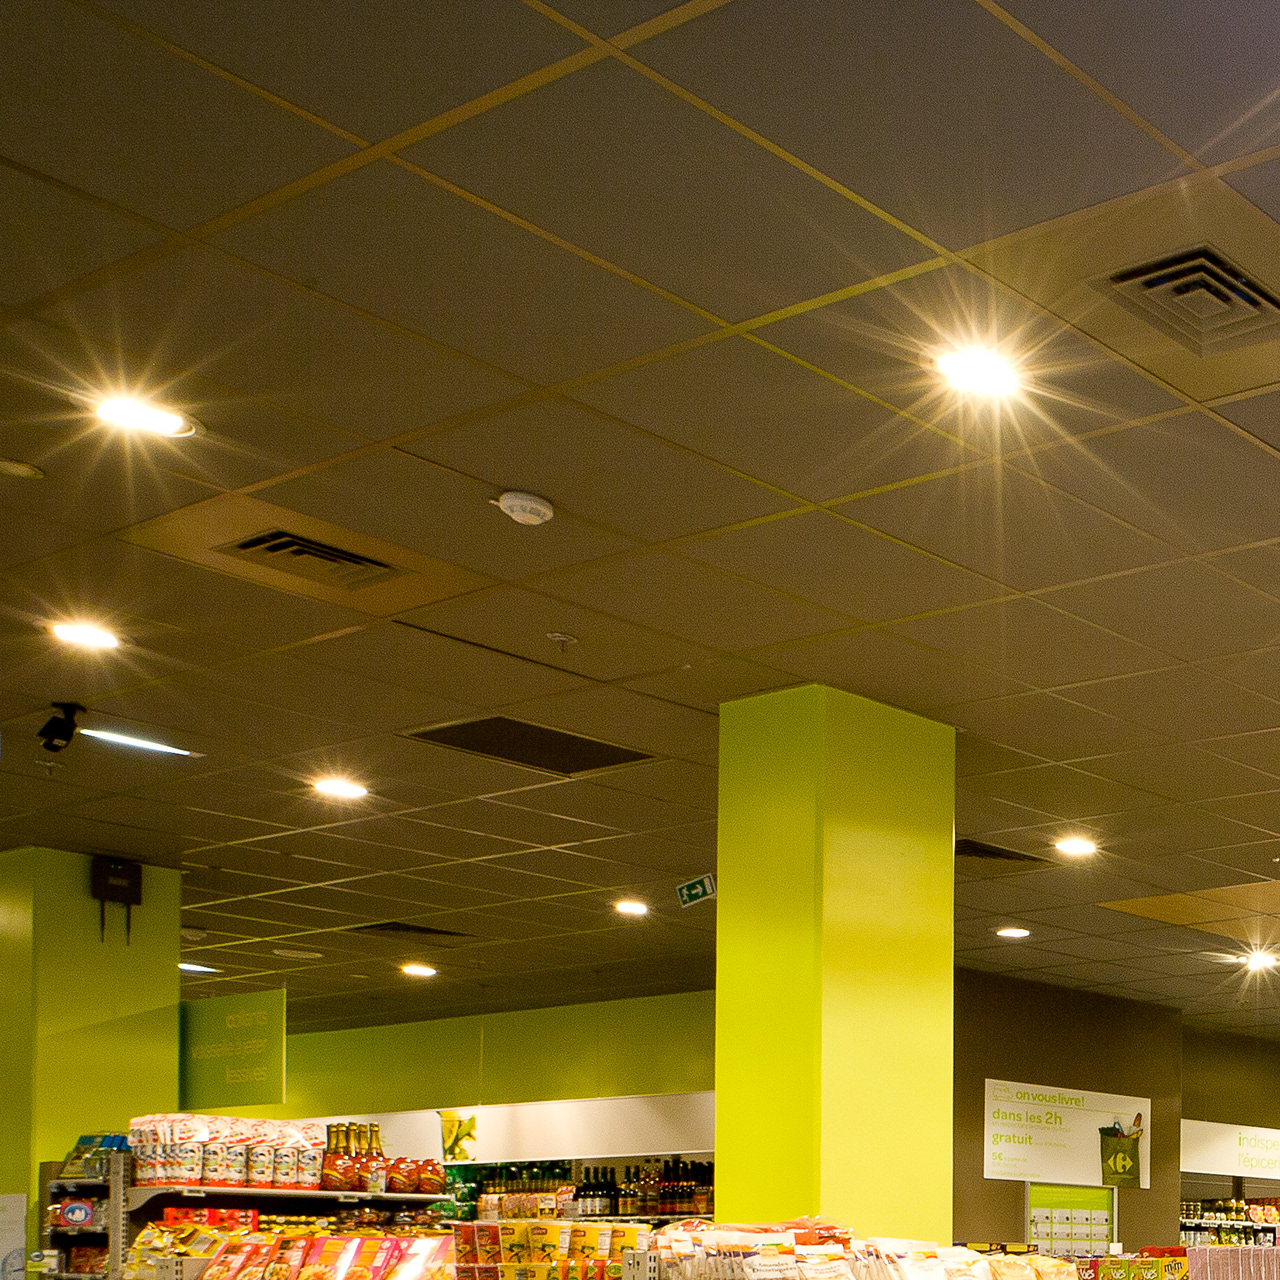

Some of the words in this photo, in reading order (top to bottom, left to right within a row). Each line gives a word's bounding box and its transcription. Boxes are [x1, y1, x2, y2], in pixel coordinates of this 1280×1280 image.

[1016, 1090, 1030, 1100] on
[1031, 1092, 1057, 1103] vous
[1058, 1094, 1085, 1107] livre!
[992, 1108, 1022, 1122] dans
[1025, 1111, 1042, 1124] les
[1045, 1112, 1062, 1125] 2h
[992, 1132, 1033, 1145] gratuit
[992, 1152, 1003, 1161] 5€
